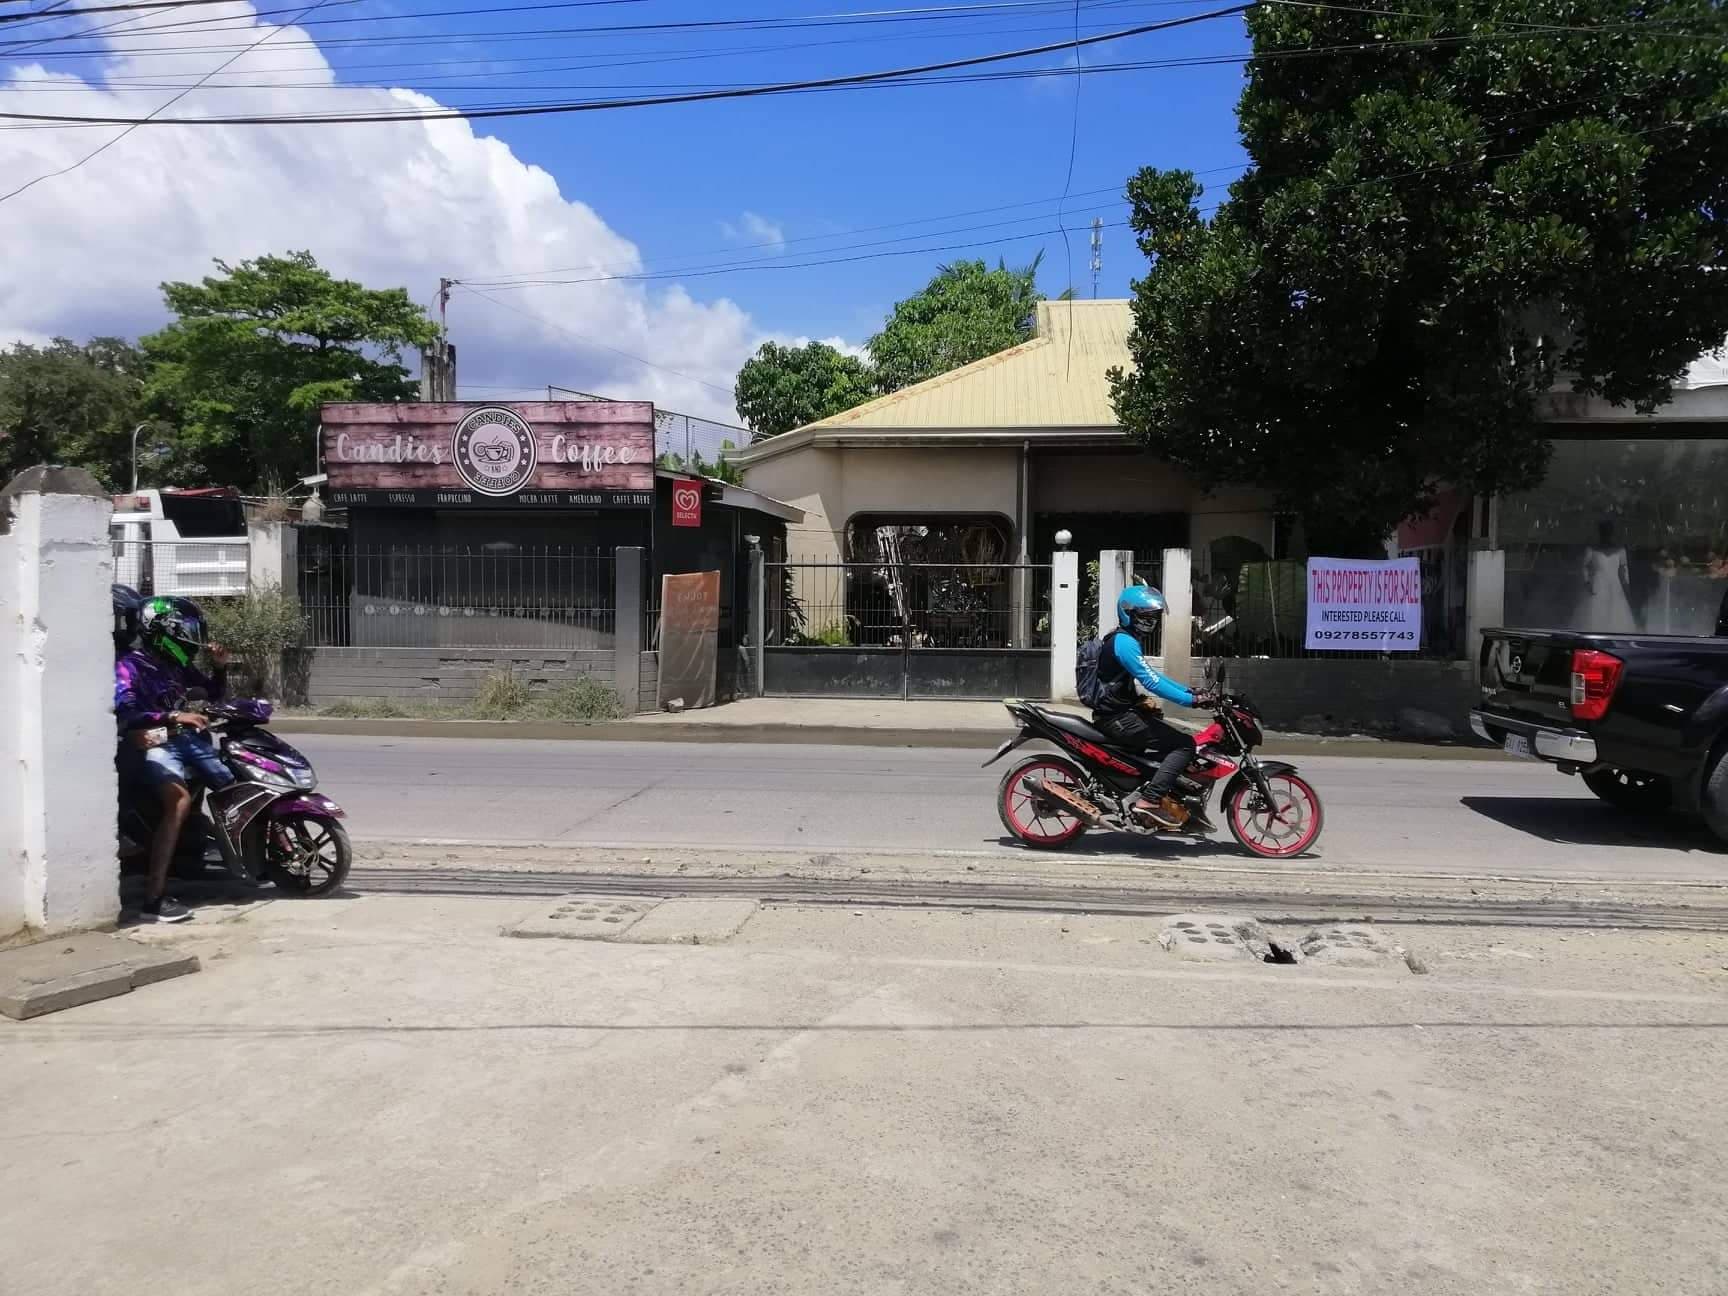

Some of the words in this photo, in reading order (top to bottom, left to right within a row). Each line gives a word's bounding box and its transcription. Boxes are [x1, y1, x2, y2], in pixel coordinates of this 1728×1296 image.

[468, 411, 521, 433] CANDIES
[337, 433, 449, 464] Candies
[551, 434, 638, 472] Coffee
[473, 470, 520, 488] COFFEE
[540, 494, 558, 504] LATTE
[568, 495, 602, 504] AMERICANO
[1312, 569, 1330, 604] THIS
[1332, 569, 1373, 604] PROPERTY
[1374, 569, 1382, 604] IS
[1384, 569, 1399, 604] FOR
[1400, 569, 1419, 604] SALE
[1322, 610, 1363, 622] INTERESTED
[1364, 610, 1389, 622] PLEASE
[1389, 610, 1406, 622] CALL
[1314, 630, 1415, 640] 09278557743
